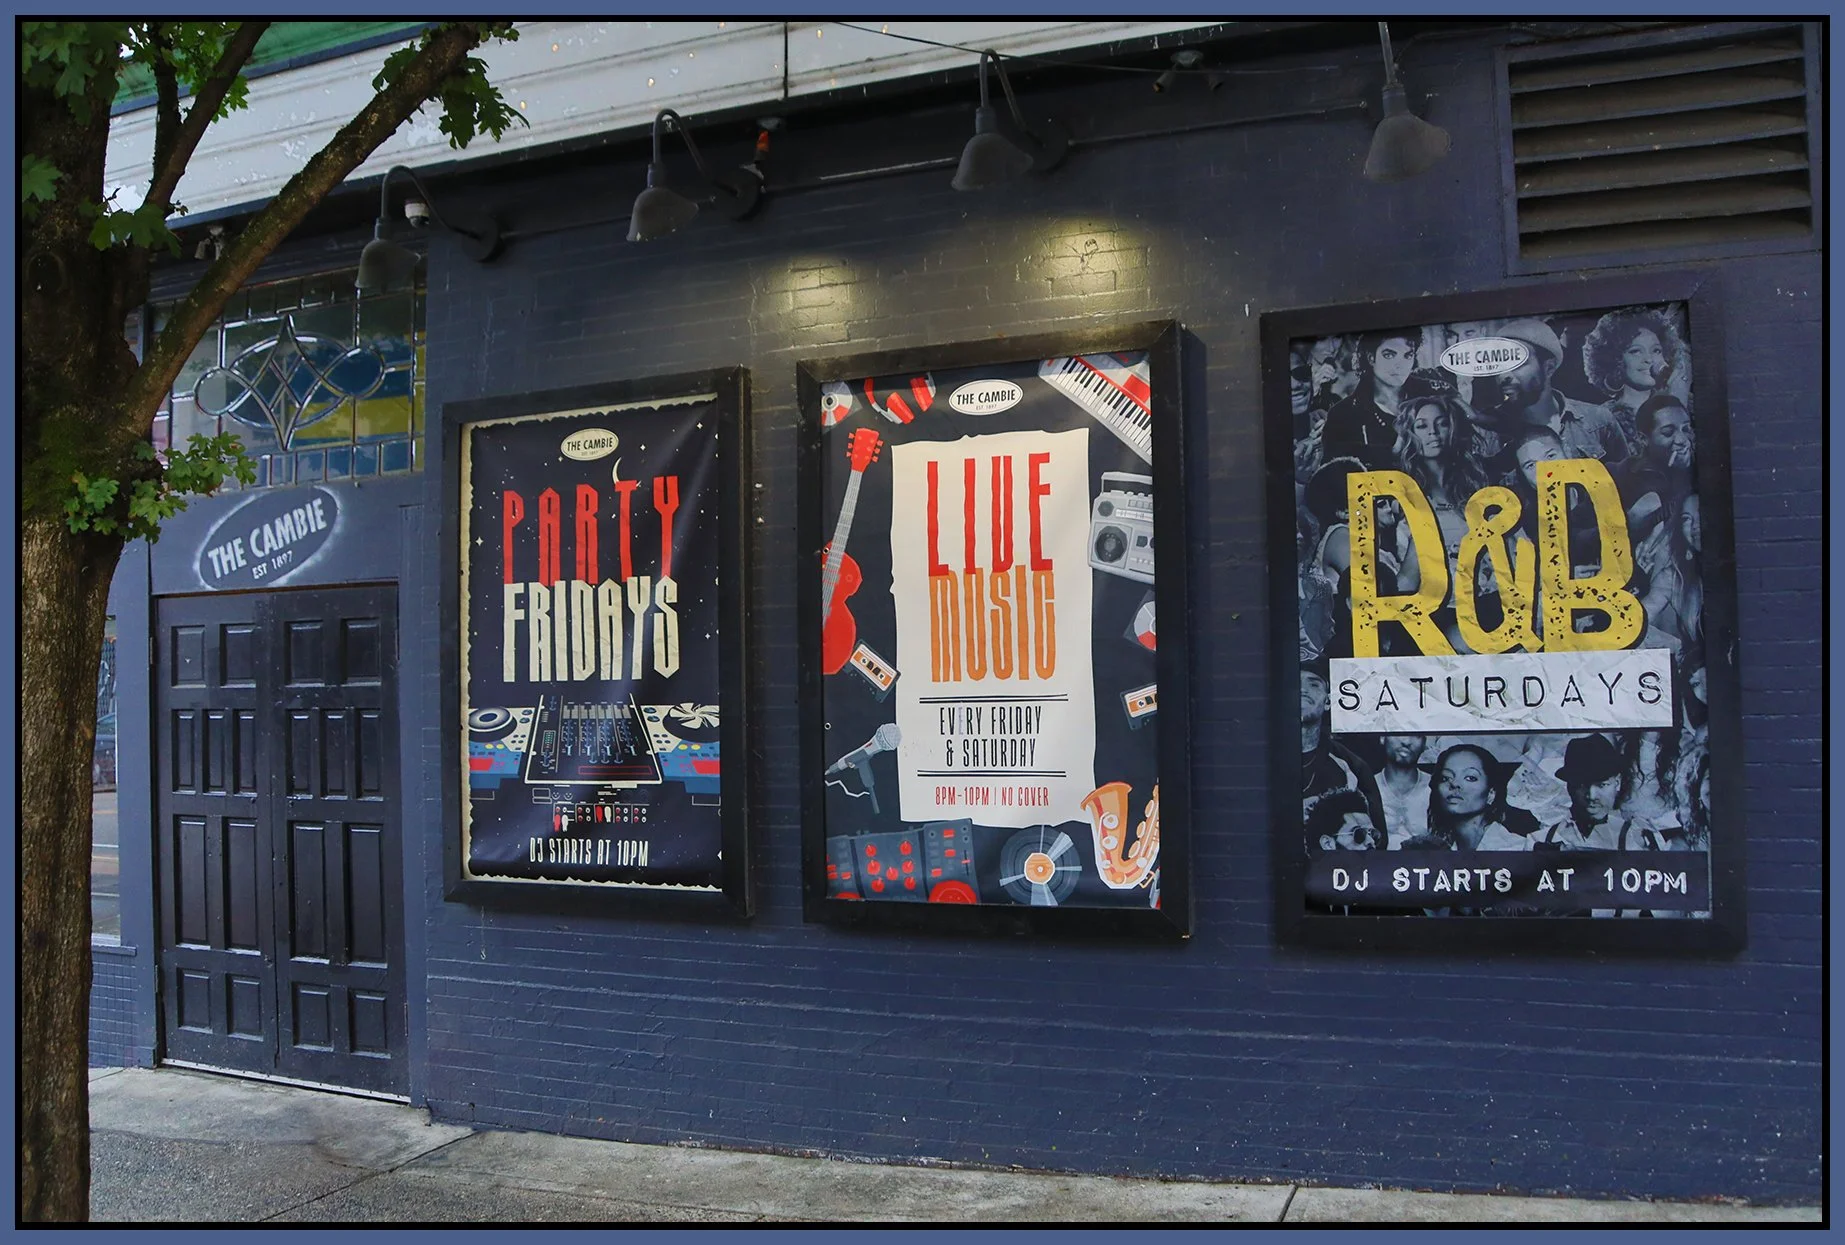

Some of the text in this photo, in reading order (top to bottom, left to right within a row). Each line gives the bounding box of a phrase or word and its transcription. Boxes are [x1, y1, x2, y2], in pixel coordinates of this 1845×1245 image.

[1448, 348, 1521, 366] THE CAMBIE
[957, 389, 1015, 405] THE CAMBIE
[567, 438, 613, 451] THE CAMBIE
[926, 452, 1052, 576] LIVE
[208, 498, 328, 579] THE CAMBIE
[503, 475, 680, 586] PARTY
[252, 550, 293, 580] EST 1897
[1346, 458, 1645, 658] R&B
[503, 575, 680, 683] FRIDAYS
[930, 565, 1056, 682] MUSIC
[1337, 671, 1664, 712] SATURDAYS
[940, 706, 1042, 735] EVERY FRIDAY
[946, 738, 1036, 767] & SATURDAY
[1002, 786, 1013, 806] NO
[1018, 786, 1049, 806] COVER
[530, 837, 649, 867] DJ STARTS AT 10PM
[1332, 867, 1688, 894] DJ STARTS AT 10PM
